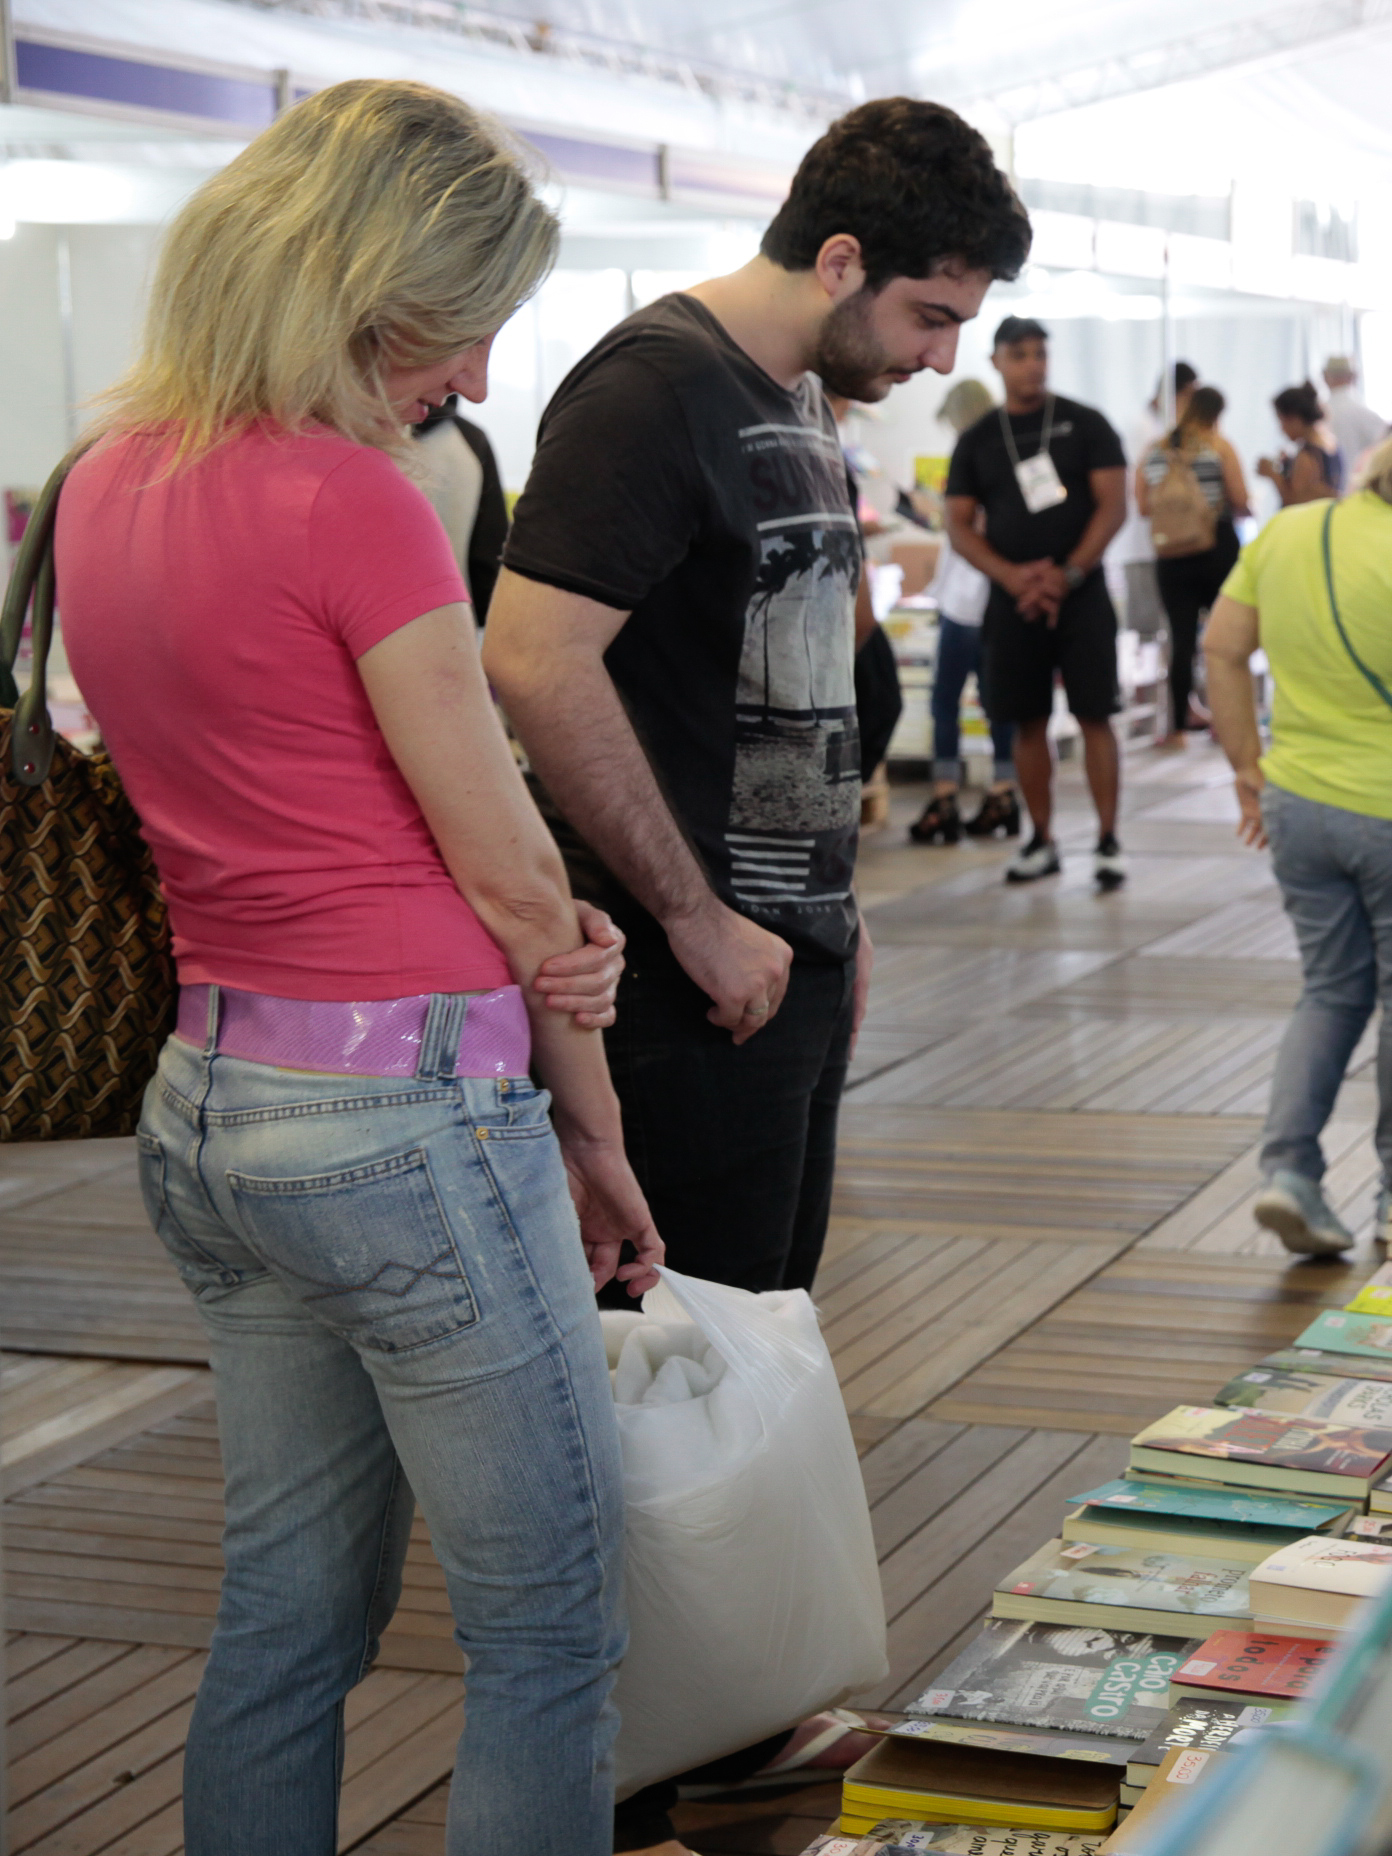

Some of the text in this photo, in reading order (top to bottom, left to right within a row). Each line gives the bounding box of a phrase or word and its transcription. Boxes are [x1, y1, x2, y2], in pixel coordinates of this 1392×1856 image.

[1175, 1571, 1218, 1595] falhar
[1200, 1568, 1247, 1602] prometo
[1218, 1640, 1280, 1681] todos
[1195, 1709, 1210, 1719] DA
[1175, 1754, 1203, 1780] 35,00
